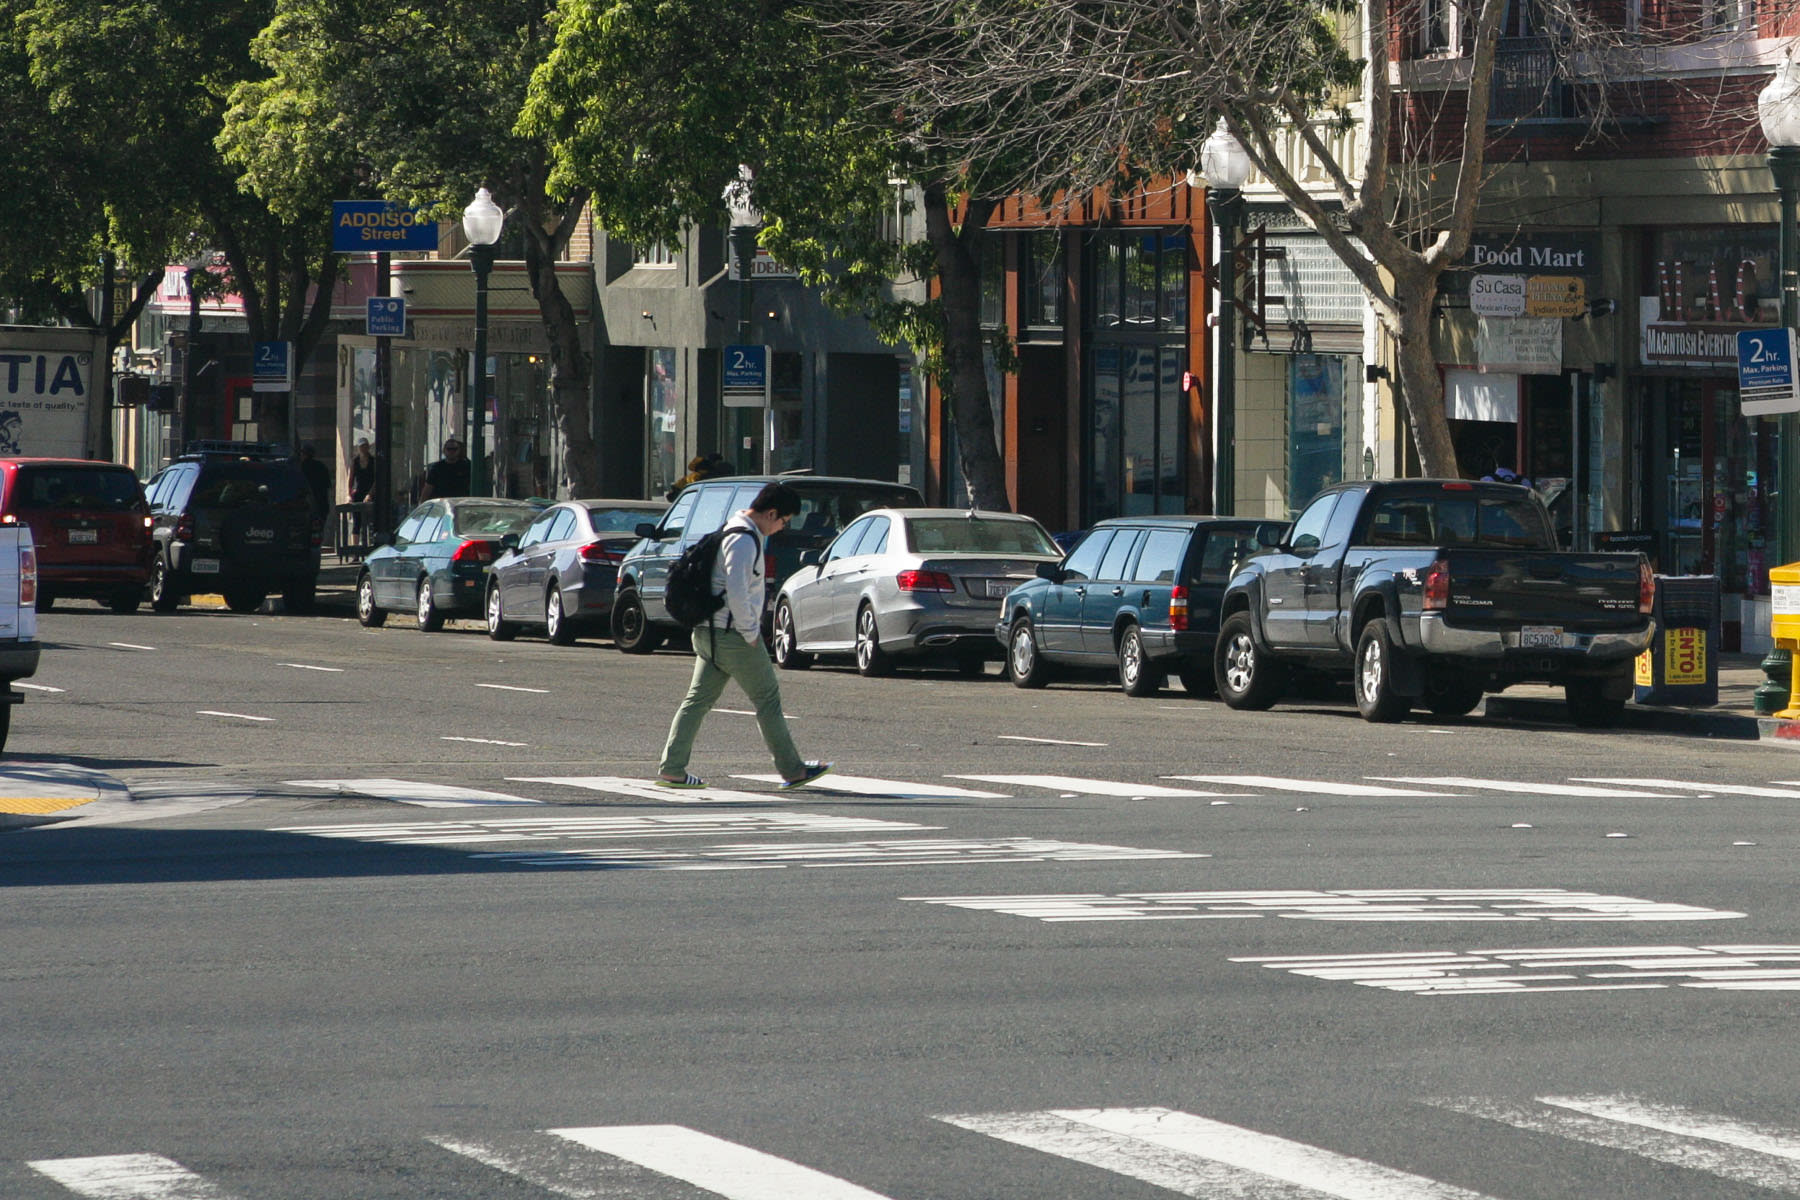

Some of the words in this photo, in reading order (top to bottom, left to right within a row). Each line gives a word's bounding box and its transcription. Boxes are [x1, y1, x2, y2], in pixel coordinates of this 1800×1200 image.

[361, 227, 407, 240] Street
[1473, 245, 1522, 265] Food
[1529, 247, 1584, 267] Mart
[1476, 280, 1491, 294] Su
[1494, 281, 1522, 294] Casa
[1647, 329, 1696, 355] MACINTOSH
[1761, 364, 1788, 373] Parking
[246, 527, 274, 539] Jeep
